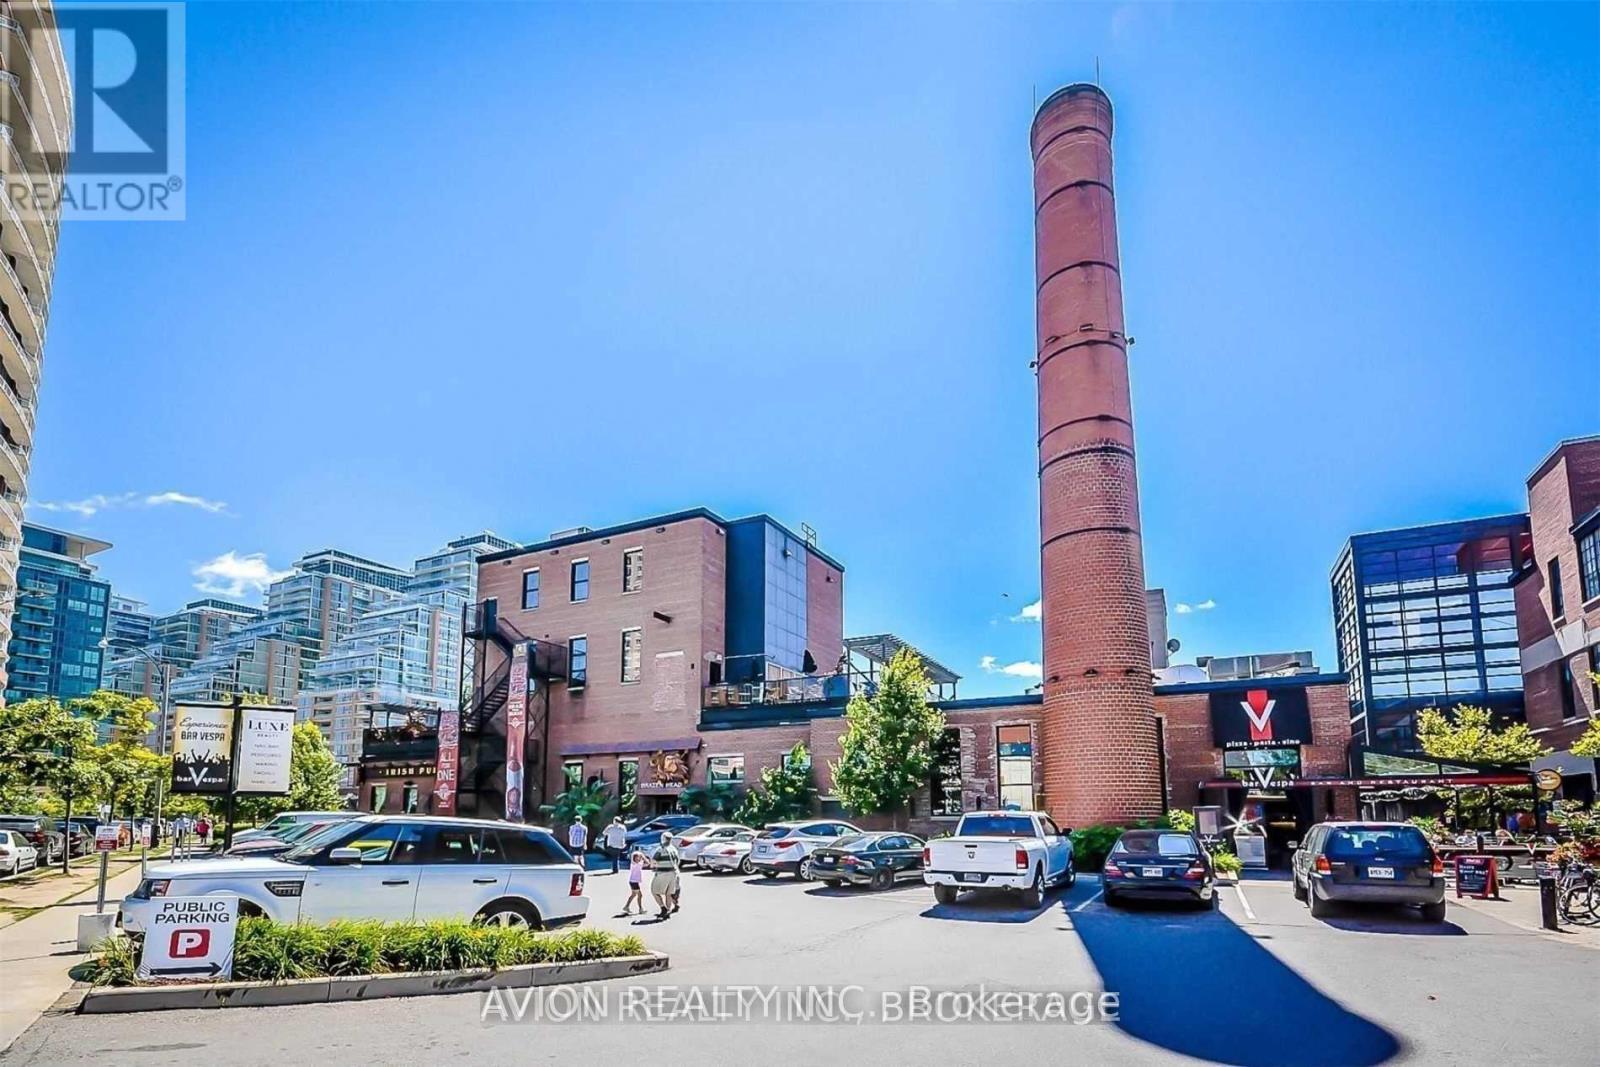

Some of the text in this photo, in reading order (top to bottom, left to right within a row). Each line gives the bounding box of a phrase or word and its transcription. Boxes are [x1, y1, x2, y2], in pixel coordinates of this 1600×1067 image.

[179, 716, 229, 731] Experience
[248, 719, 289, 732] LUXE
[180, 730, 226, 742] BAR VESPA
[385, 767, 415, 776] IRISH
[437, 770, 455, 781] ONE
[163, 902, 226, 913] PUBLIC
[155, 912, 230, 924] PARKING
[176, 932, 203, 956] P
